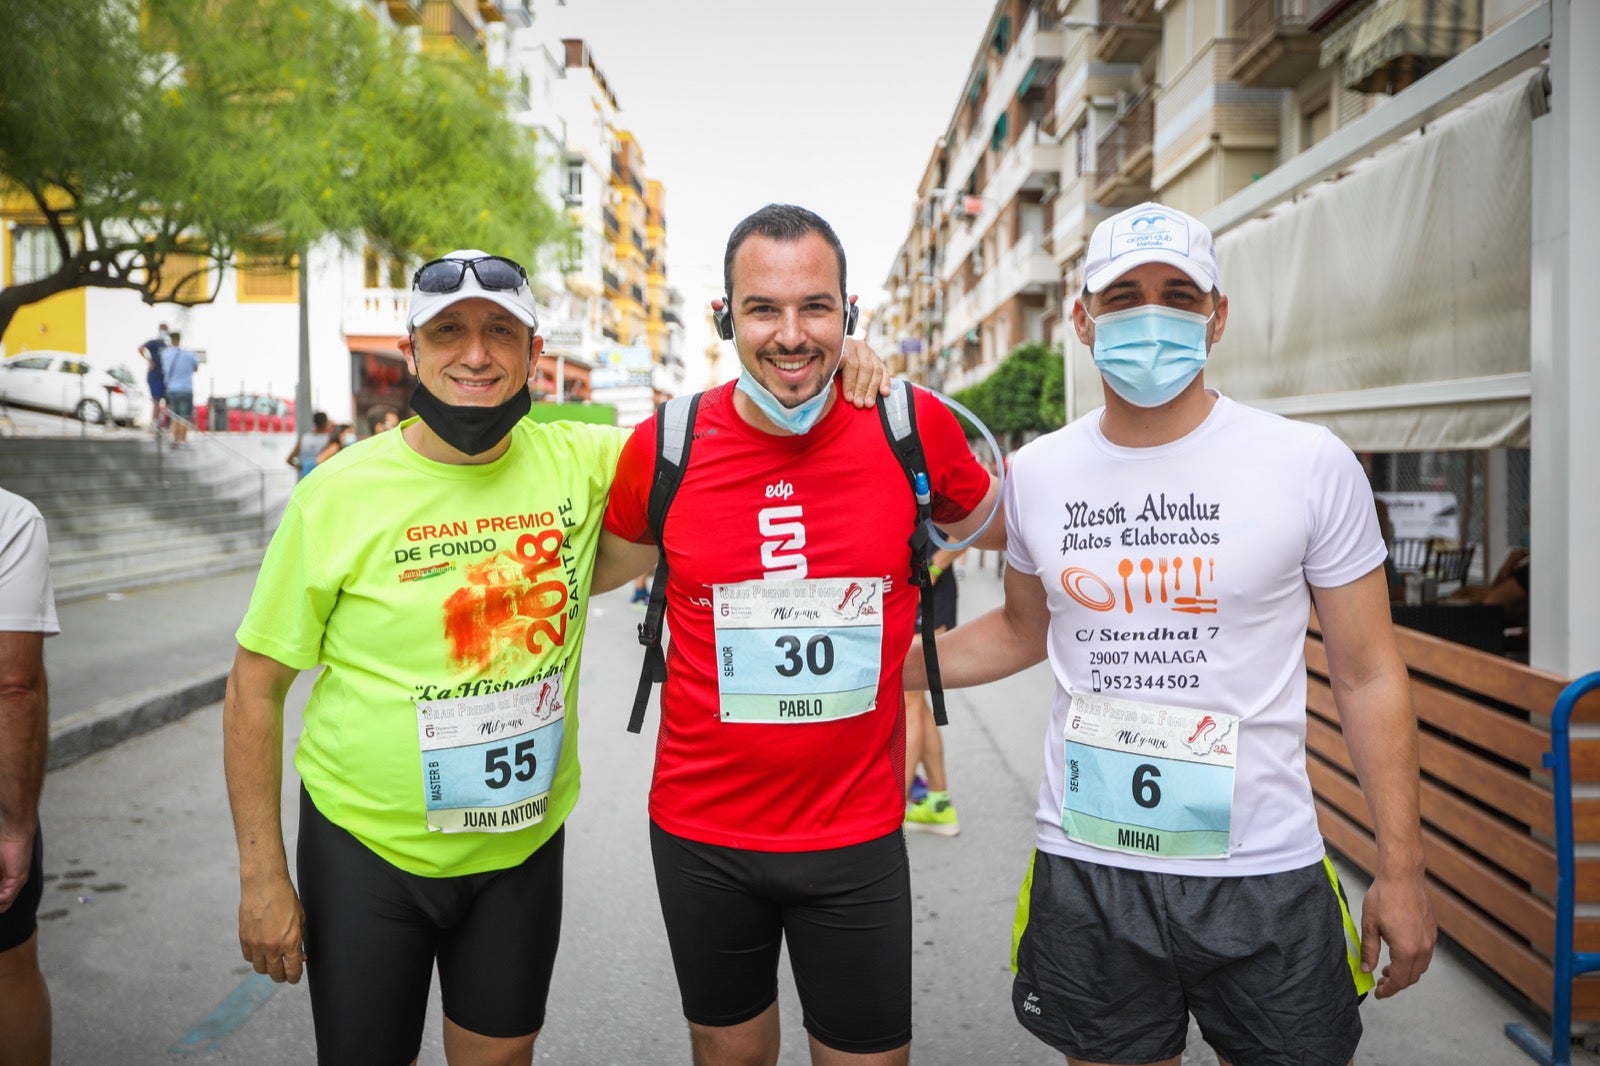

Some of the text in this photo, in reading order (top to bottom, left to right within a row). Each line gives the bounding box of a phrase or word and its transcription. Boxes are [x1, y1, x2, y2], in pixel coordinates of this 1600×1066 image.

[765, 479, 795, 500] edp
[1063, 492, 1220, 530] Mesón Alvaluz
[406, 511, 555, 542] GRAN PREMIO
[1060, 526, 1220, 556] Platos Elaborados
[394, 538, 497, 564] DE FONDO
[558, 498, 579, 619] SANTA FE
[516, 529, 568, 655] 2018
[770, 607, 794, 620] Mil
[1075, 627, 1220, 642] C/ Stendhal 7
[723, 646, 734, 677] SENIOR
[774, 634, 835, 677] 30
[1089, 649, 1208, 665] 29007 MALAGA
[1103, 674, 1200, 690] 952344502
[779, 699, 823, 717] PABLO
[477, 719, 500, 735] Mil
[1116, 729, 1139, 745] Mil
[484, 738, 537, 789] 55
[1070, 759, 1079, 793] SENIOR
[430, 770, 442, 801] MASTER
[1131, 763, 1162, 809] 6
[463, 796, 549, 828] JUAN ANTONIO
[1118, 828, 1160, 852] MIHAI
